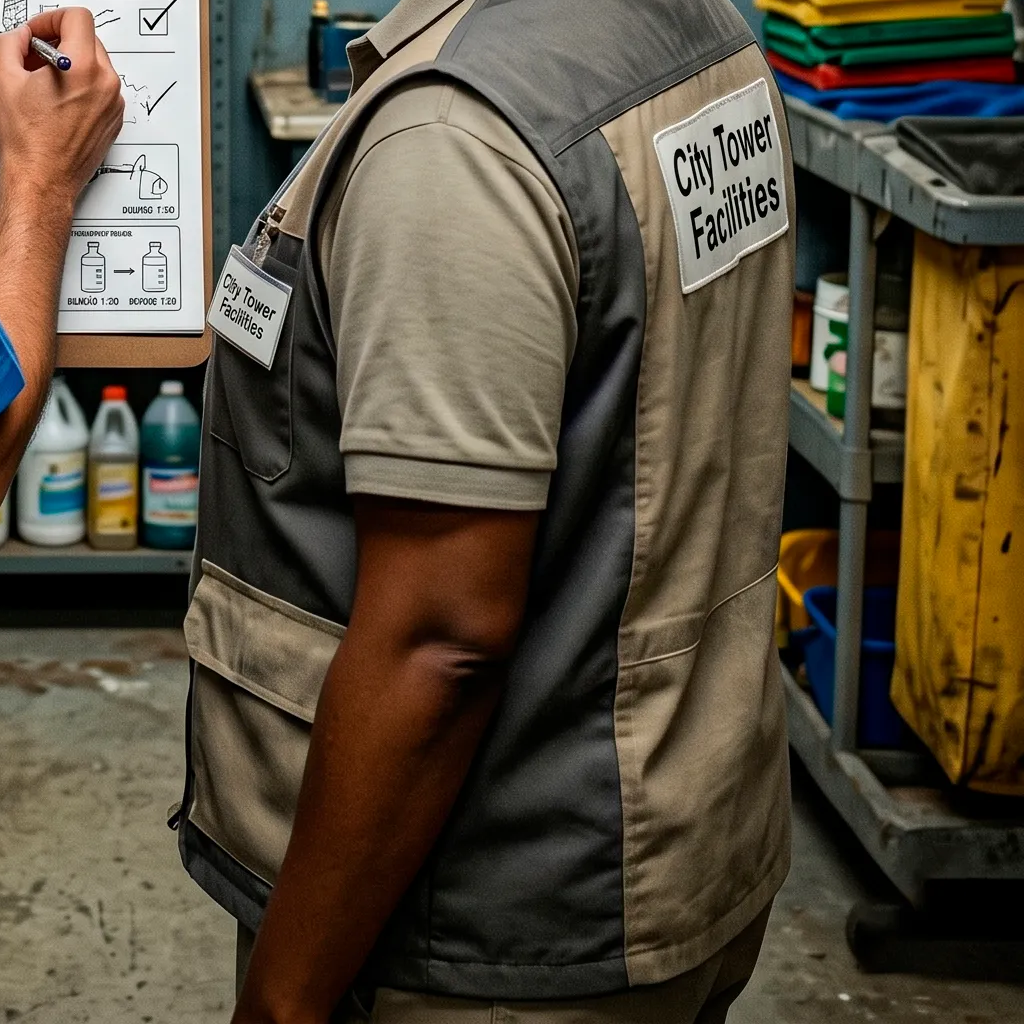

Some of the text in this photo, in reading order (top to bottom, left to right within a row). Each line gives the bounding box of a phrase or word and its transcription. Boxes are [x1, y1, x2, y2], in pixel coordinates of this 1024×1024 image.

[673, 114, 773, 197] City Tower
[690, 176, 780, 259] Facilities
[219, 297, 264, 340] Facilities
[241, 286, 277, 321] Tower
